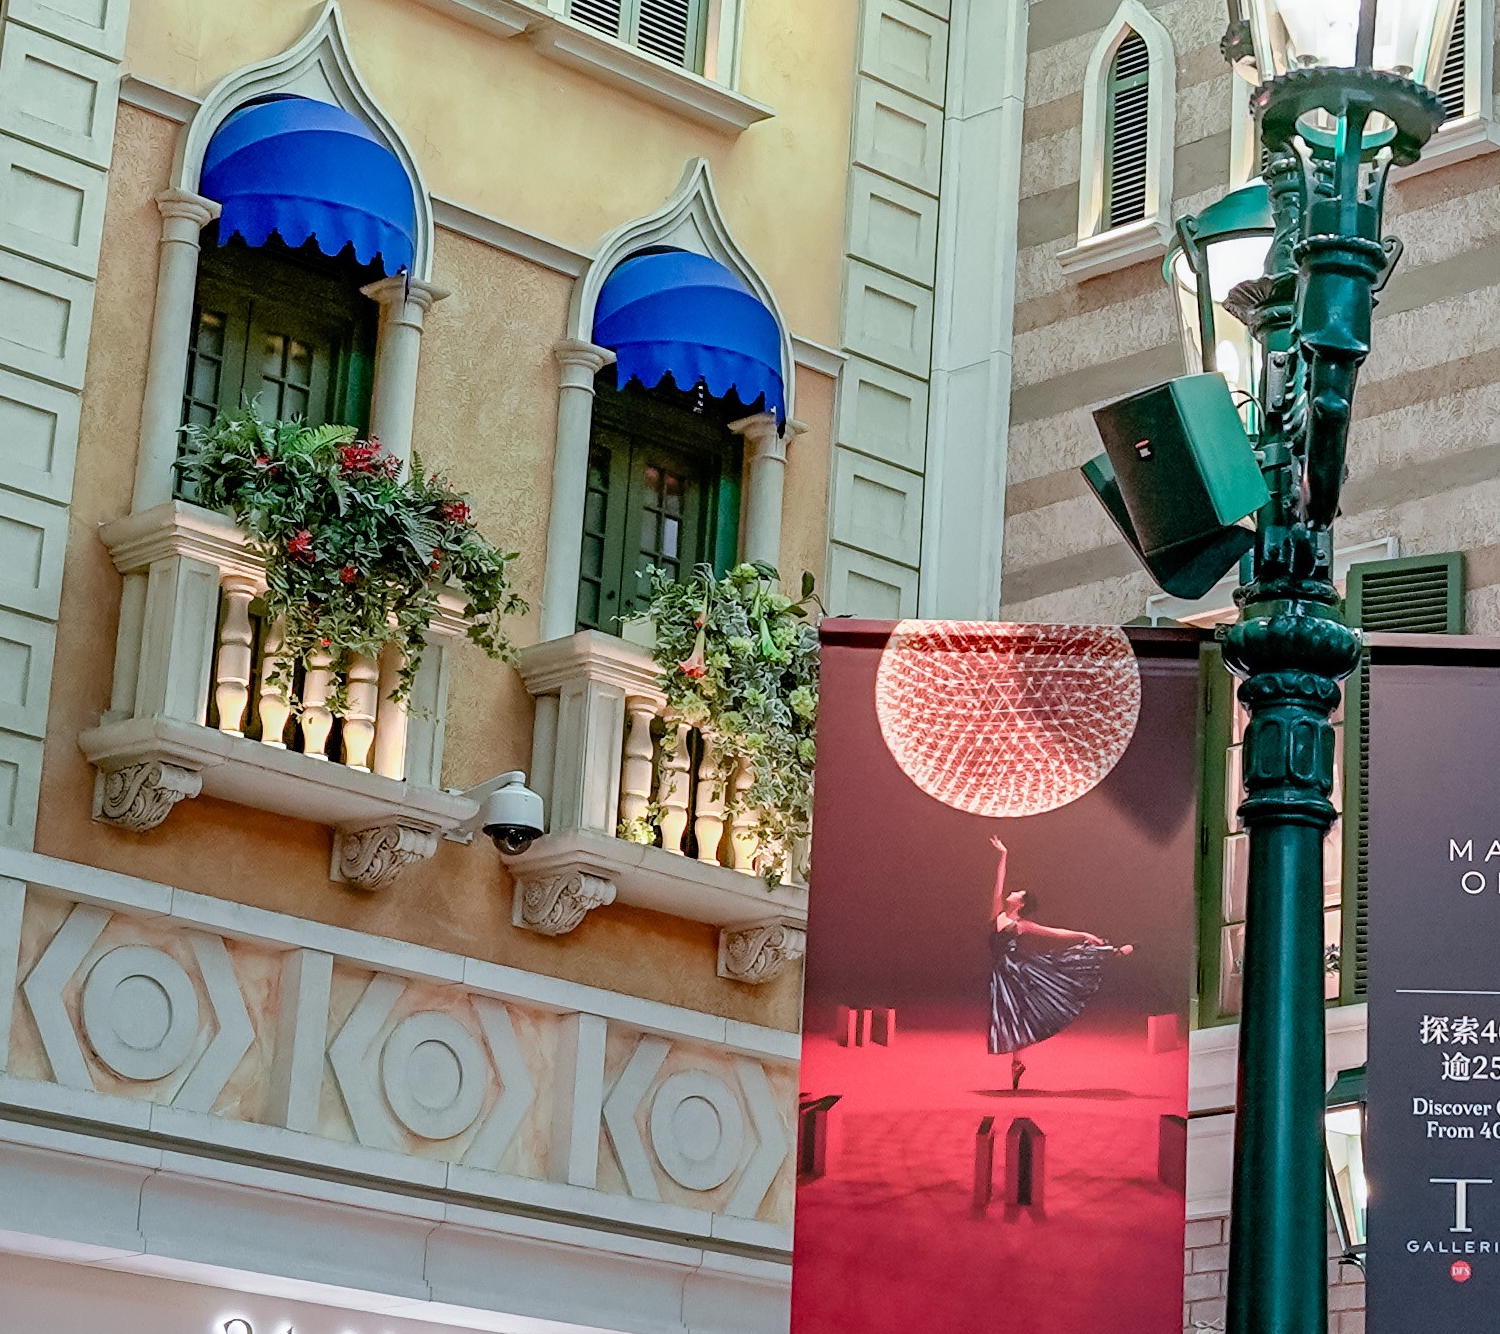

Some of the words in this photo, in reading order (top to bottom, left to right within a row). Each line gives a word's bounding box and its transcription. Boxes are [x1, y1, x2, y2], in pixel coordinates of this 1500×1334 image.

[1412, 1097, 1492, 1117] Discover
[1426, 1120, 1475, 1140] From
[1428, 1176, 1494, 1234] T
